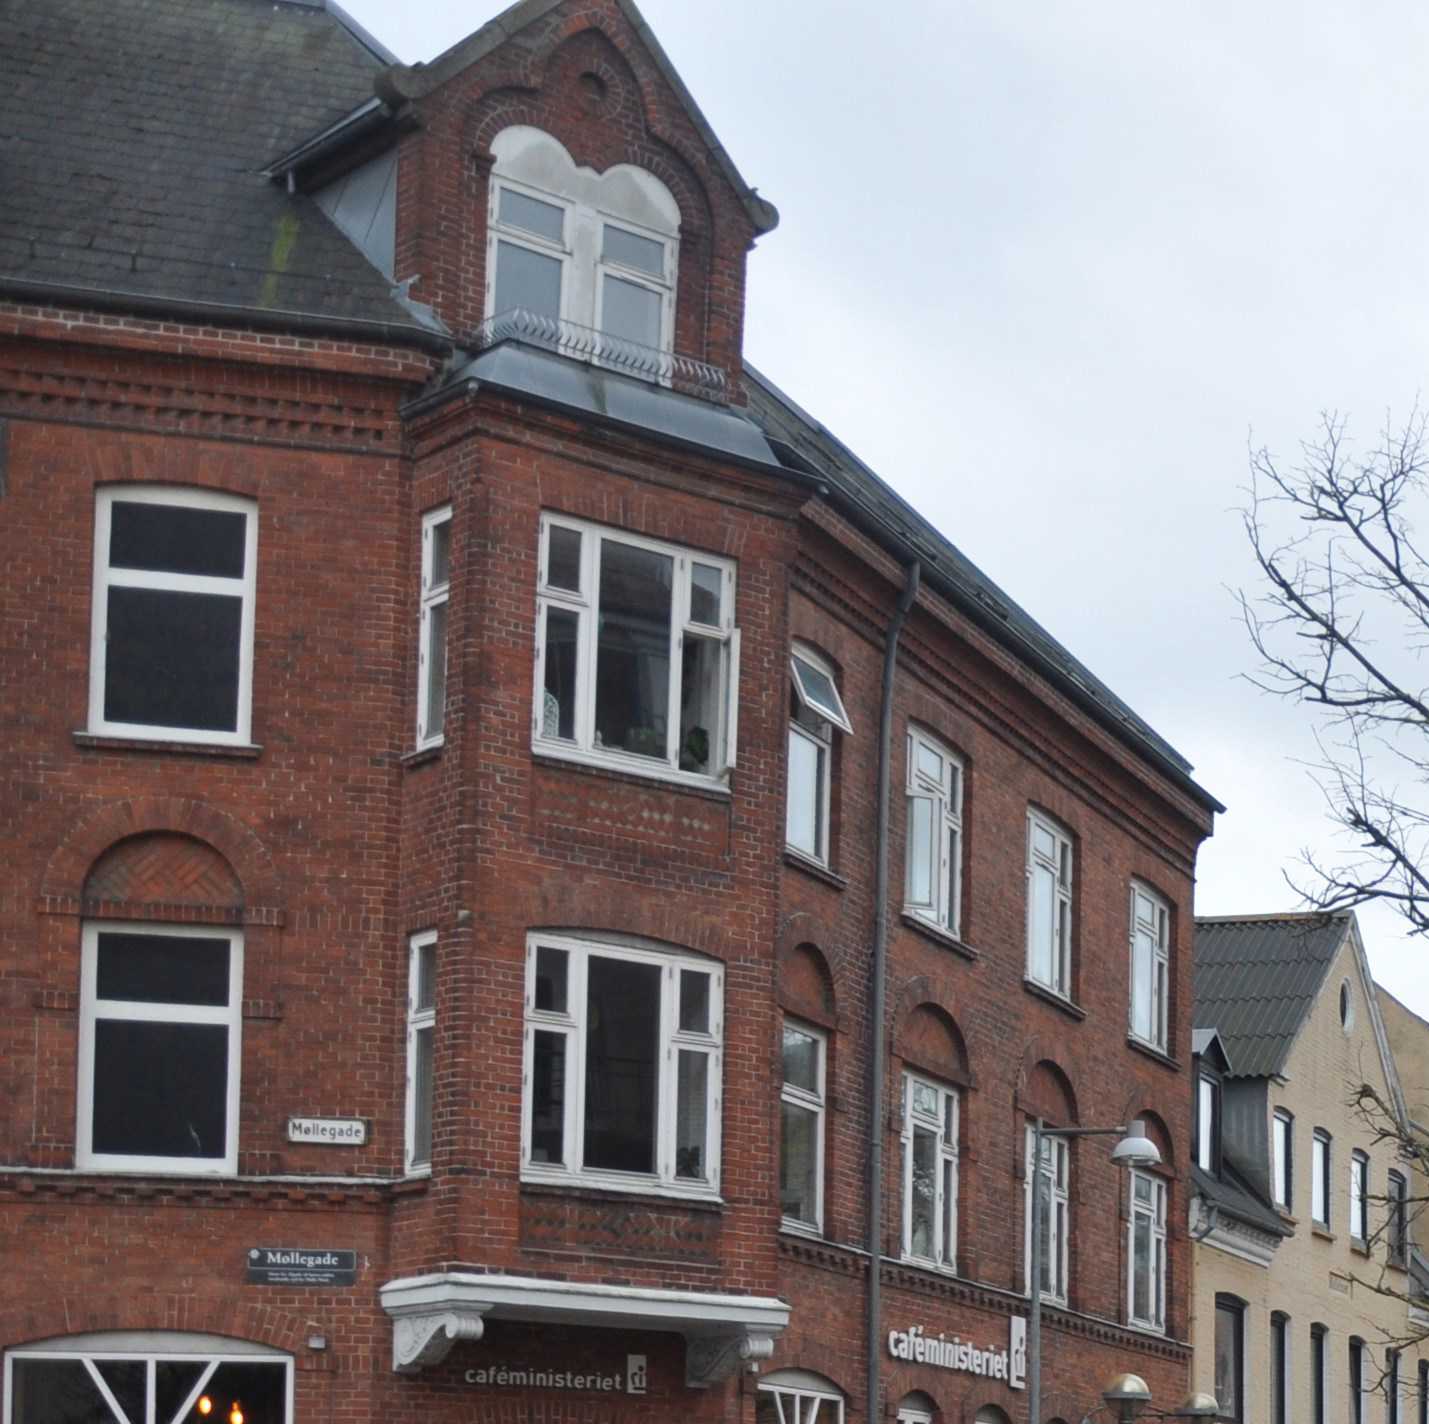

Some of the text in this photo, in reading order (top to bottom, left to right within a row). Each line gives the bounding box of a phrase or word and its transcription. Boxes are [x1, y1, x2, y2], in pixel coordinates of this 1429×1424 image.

[291, 1121, 362, 1140] Møllegade
[267, 1251, 339, 1268] Møllegade
[888, 1325, 1008, 1380] caféministeriet
[465, 1366, 622, 1391] caféministeriet
